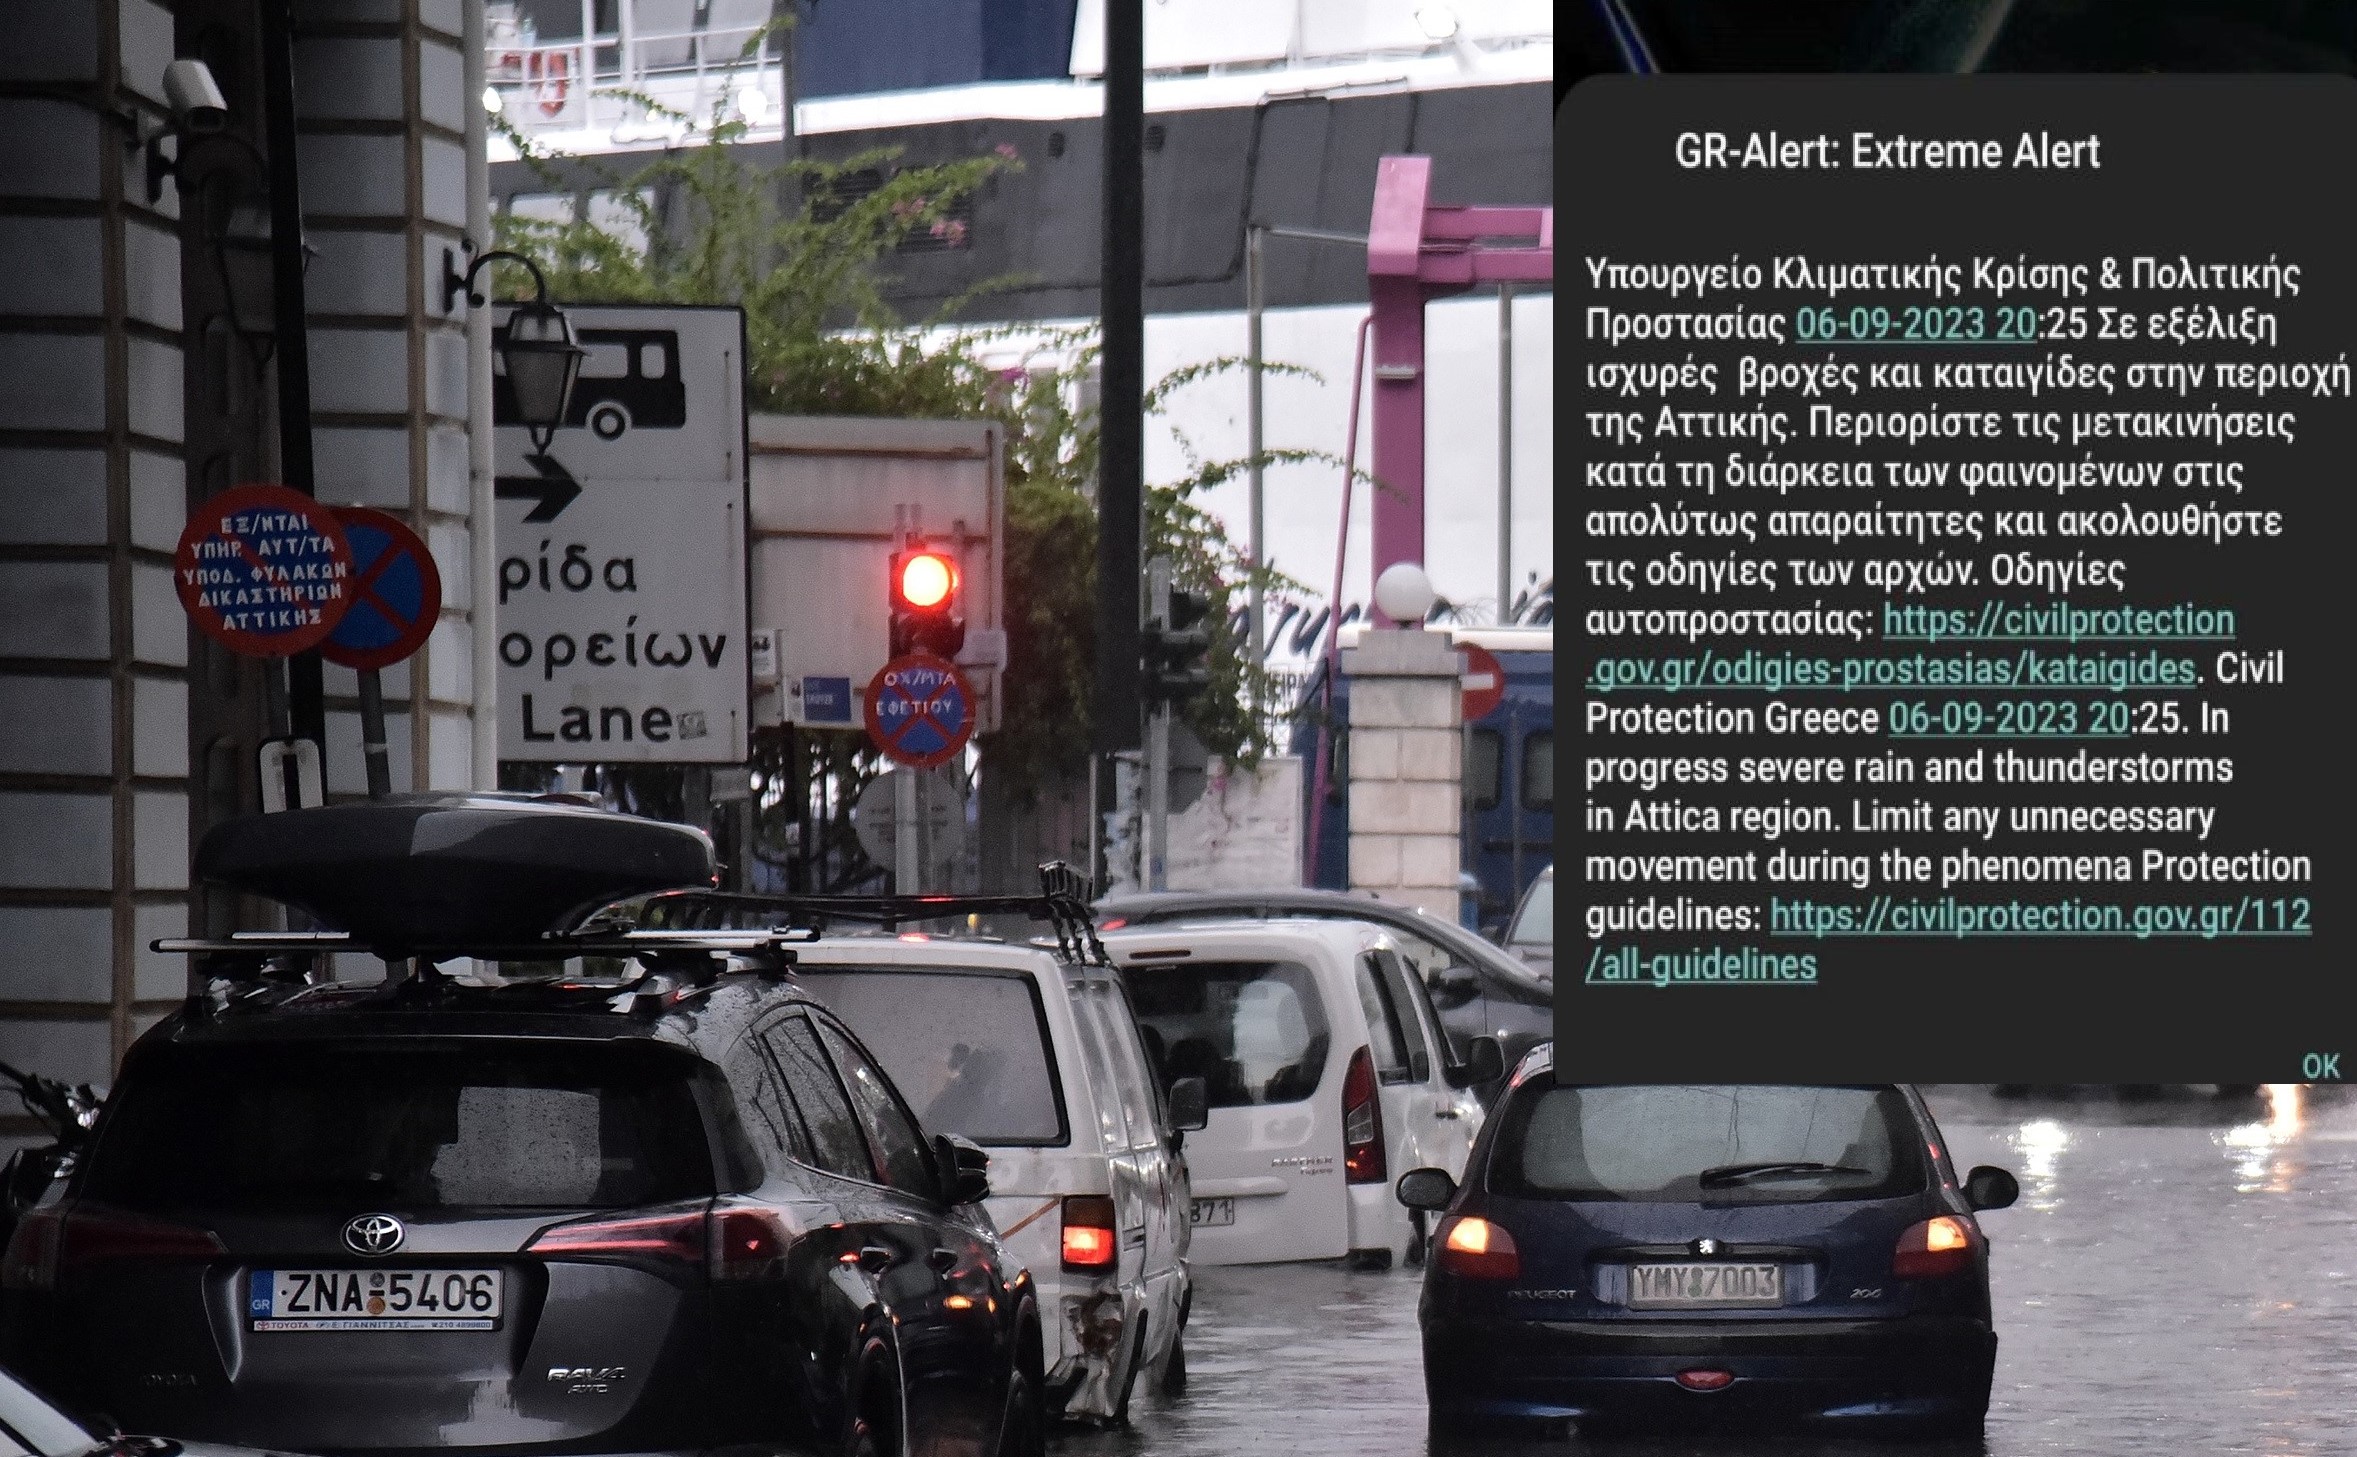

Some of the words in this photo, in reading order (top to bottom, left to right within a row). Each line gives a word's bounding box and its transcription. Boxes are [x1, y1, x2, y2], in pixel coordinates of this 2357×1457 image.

[250, 562, 347, 583] ΦΥΛΑΚΩΝ
[499, 539, 637, 605] ρίδα
[198, 584, 342, 608] ΔΙΚΑΣΤΗΡΙΩΝ
[222, 608, 322, 631] ΑΤΤΙΚΗΣ
[499, 615, 726, 681] ορείων
[522, 694, 673, 742] Lane
[1190, 1200, 1229, 1222] 871
[252, 1299, 270, 1311] GR
[271, 1321, 309, 1329] TOYOTA
